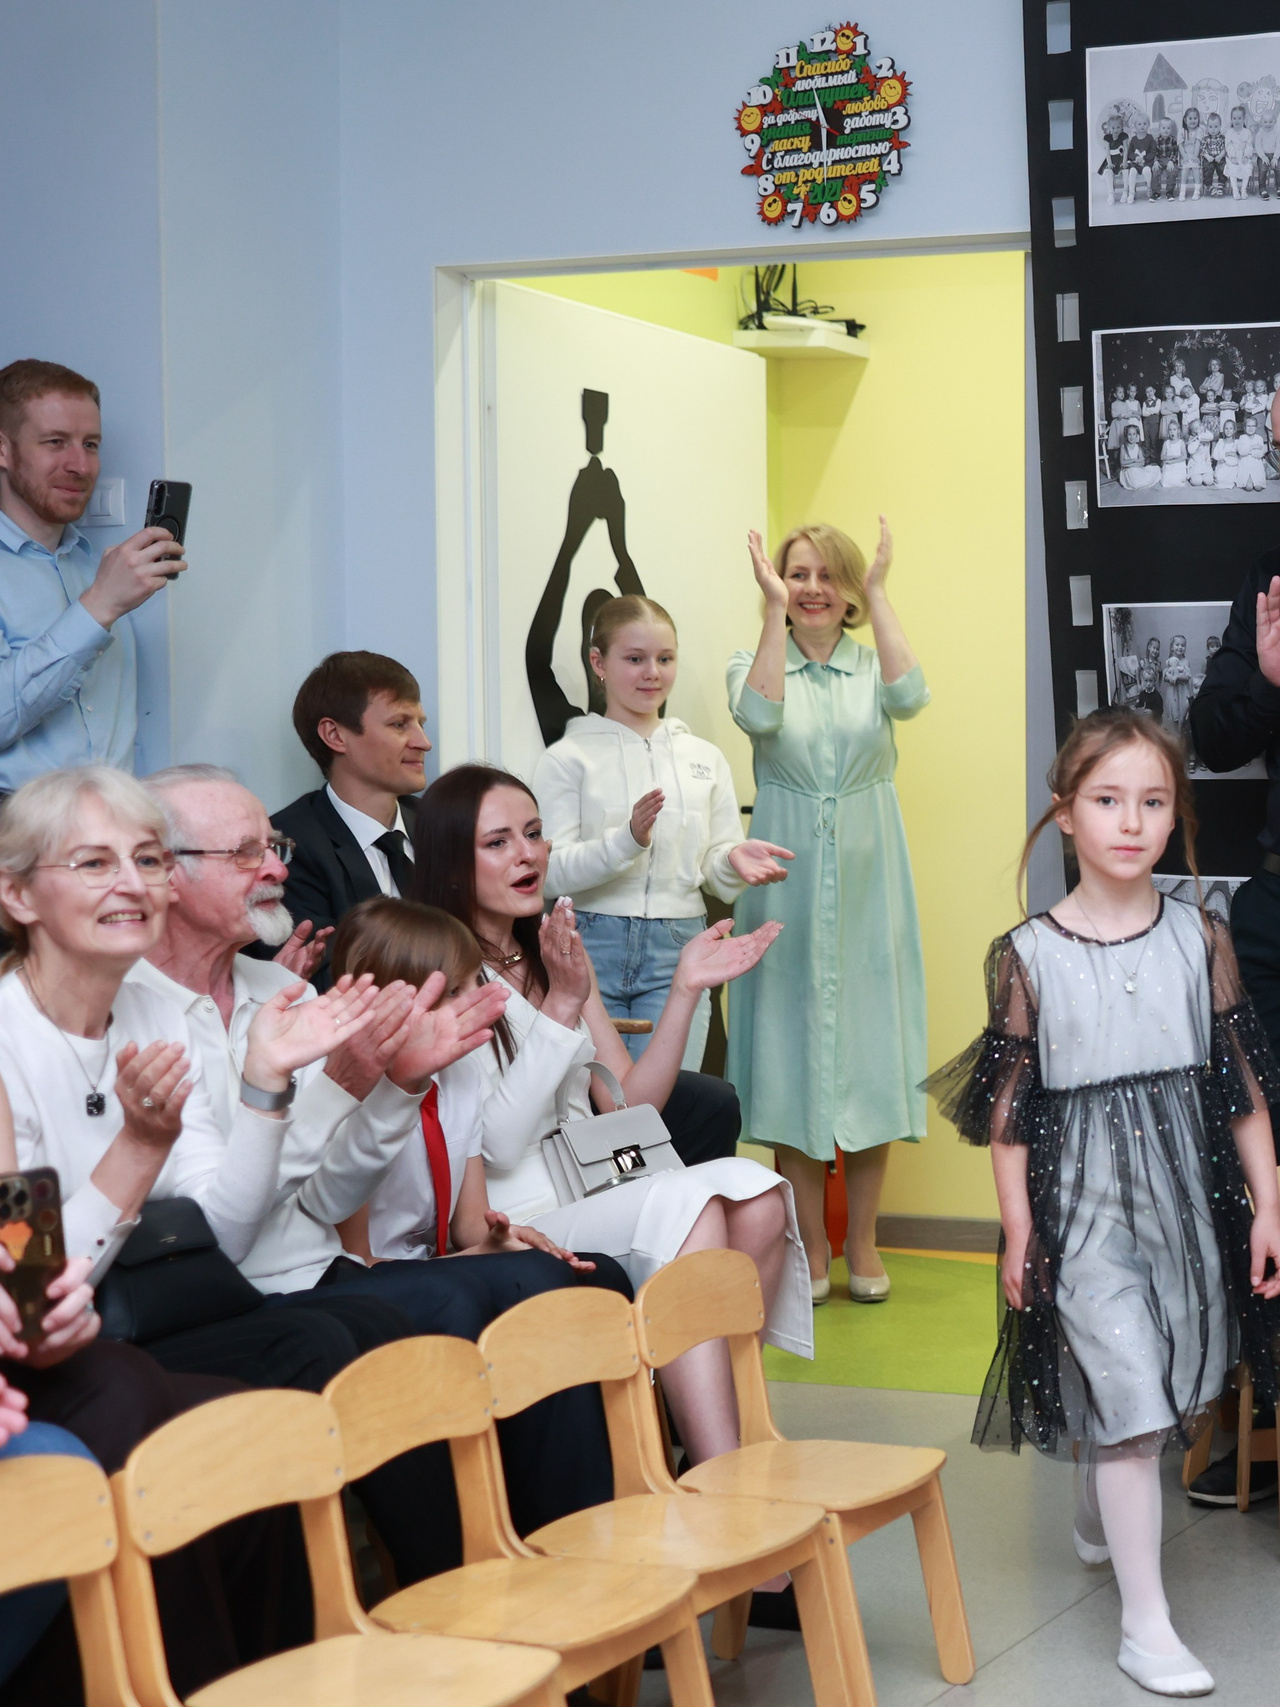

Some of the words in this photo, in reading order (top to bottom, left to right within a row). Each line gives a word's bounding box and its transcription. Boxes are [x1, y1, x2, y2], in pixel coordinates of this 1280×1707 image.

[809, 31, 837, 53] 12
[852, 34, 869, 56] 1
[775, 46, 799, 68] 11
[795, 54, 853, 78] Спасибо
[875, 57, 893, 78] 2
[792, 69, 858, 92] любимый
[747, 85, 773, 106] 10
[842, 94, 888, 115] любовь
[762, 115, 776, 128] за
[777, 108, 818, 126] доброту
[843, 111, 893, 134] заботу
[890, 105, 909, 130] 3
[744, 134, 761, 157] 9
[761, 122, 812, 146] знания
[769, 135, 812, 153] ласку
[836, 128, 894, 150] терпение
[762, 153, 772, 171] С
[773, 141, 893, 168] благодарностью
[882, 149, 900, 174] 4
[774, 170, 798, 185] от
[798, 157, 881, 187] родителей
[758, 174, 775, 196] 8
[860, 183, 877, 208] 5
[787, 202, 803, 226] 7
[820, 202, 837, 225] 6
